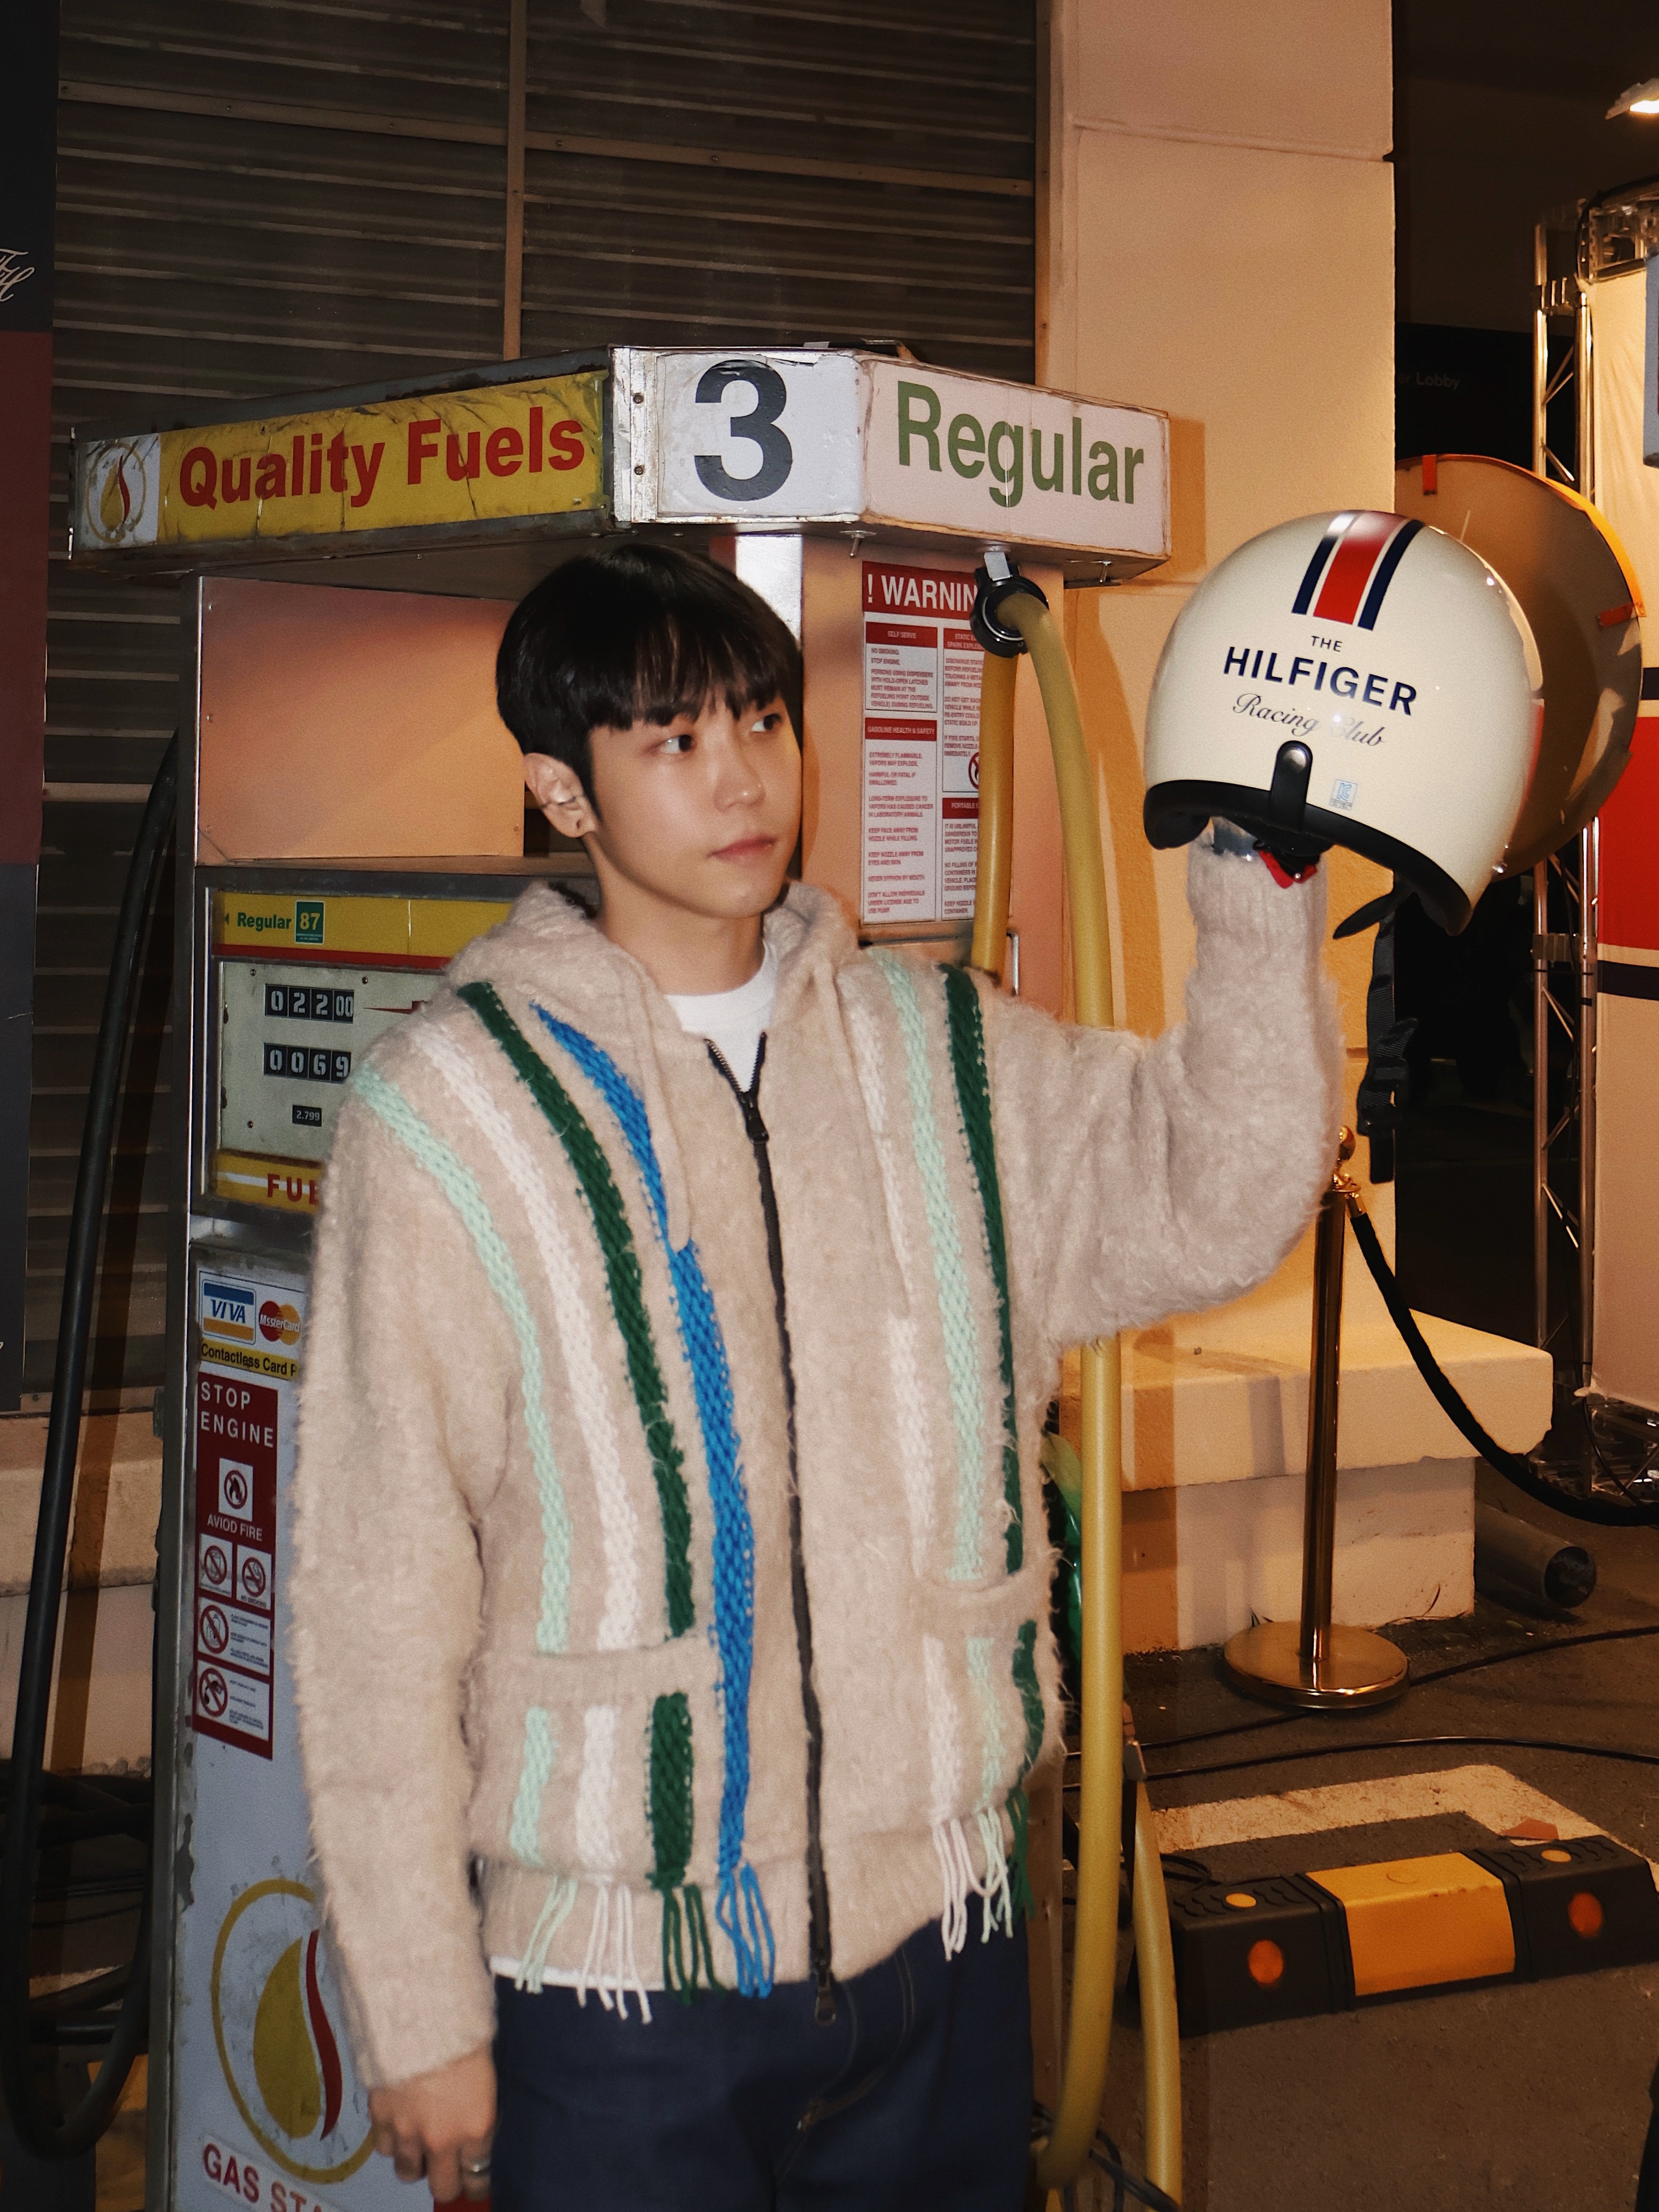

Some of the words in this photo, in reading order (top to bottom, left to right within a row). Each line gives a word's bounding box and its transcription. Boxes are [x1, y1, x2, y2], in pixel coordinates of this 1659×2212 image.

[694, 359, 792, 501] 3
[897, 380, 1144, 507] Regular
[179, 433, 386, 508] Quality
[407, 407, 584, 485] Fuels
[881, 575, 978, 612] WARNIN
[1311, 635, 1343, 652] THE
[1223, 646, 1417, 716] HILFIGER
[1233, 693, 1319, 737] Racing
[237, 912, 292, 932] Regular
[300, 912, 320, 930] 87
[296, 1110, 320, 1121] 2.799
[268, 1173, 319, 1205] FUE
[211, 1299, 245, 1323] VIVA
[201, 1345, 260, 1369] Contactless
[263, 1357, 288, 1375] Card
[201, 1381, 251, 1410] STOP
[201, 1411, 273, 1448] ENGINE
[207, 1514, 238, 1534] AVIOD
[240, 1524, 263, 1542] FIRE
[203, 2142, 260, 2204] GAS
